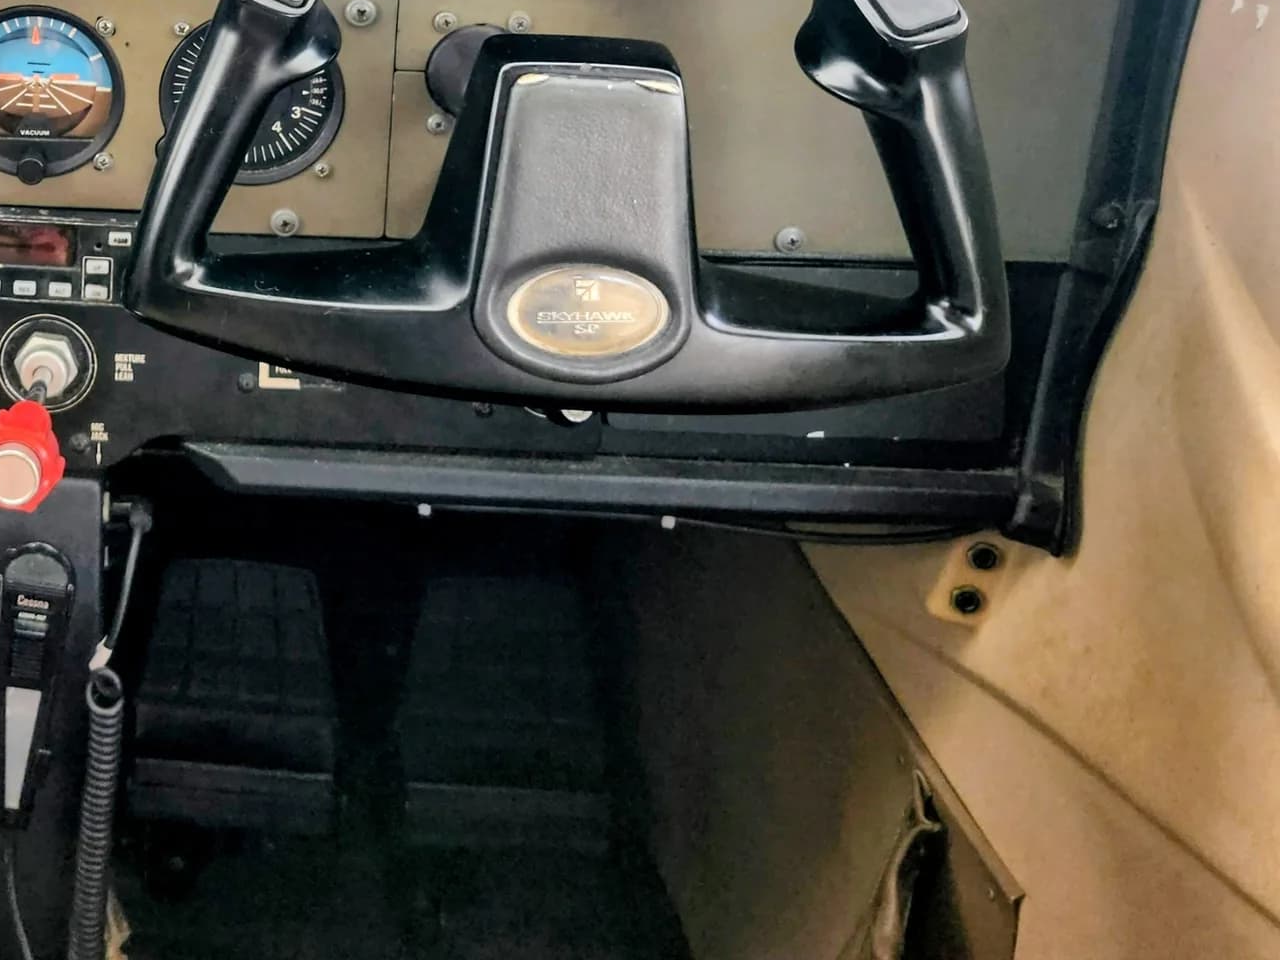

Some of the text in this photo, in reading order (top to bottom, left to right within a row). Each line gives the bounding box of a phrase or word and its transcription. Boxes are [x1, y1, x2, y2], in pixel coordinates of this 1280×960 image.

[291, 106, 301, 119] 3
[272, 121, 282, 133] 4
[536, 311, 634, 322] SKYHAWK
[574, 324, 599, 335] SP
